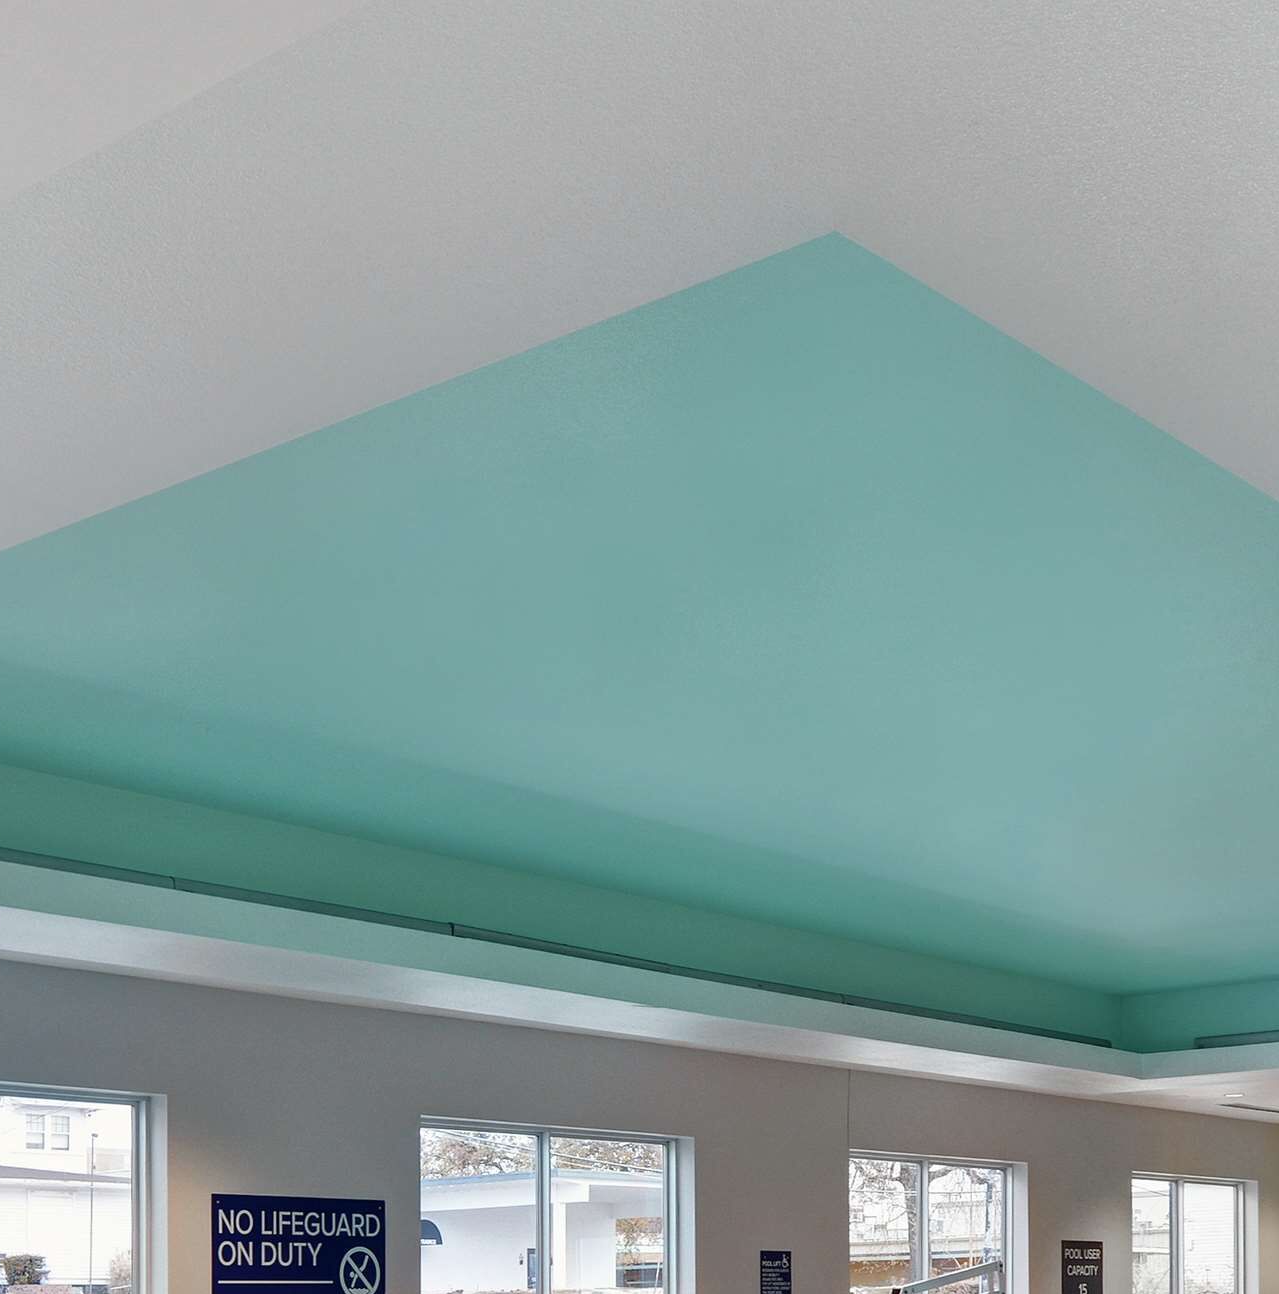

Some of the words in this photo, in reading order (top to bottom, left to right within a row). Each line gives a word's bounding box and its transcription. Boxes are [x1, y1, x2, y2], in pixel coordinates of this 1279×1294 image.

[218, 1209, 254, 1235] NO
[261, 1210, 381, 1237] LIFEGUARD
[218, 1241, 253, 1266] ON
[261, 1241, 322, 1267] DUTY
[1065, 1248, 1083, 1259] POOL
[1084, 1249, 1101, 1260] USER
[1067, 1265, 1099, 1276] CAPACITY
